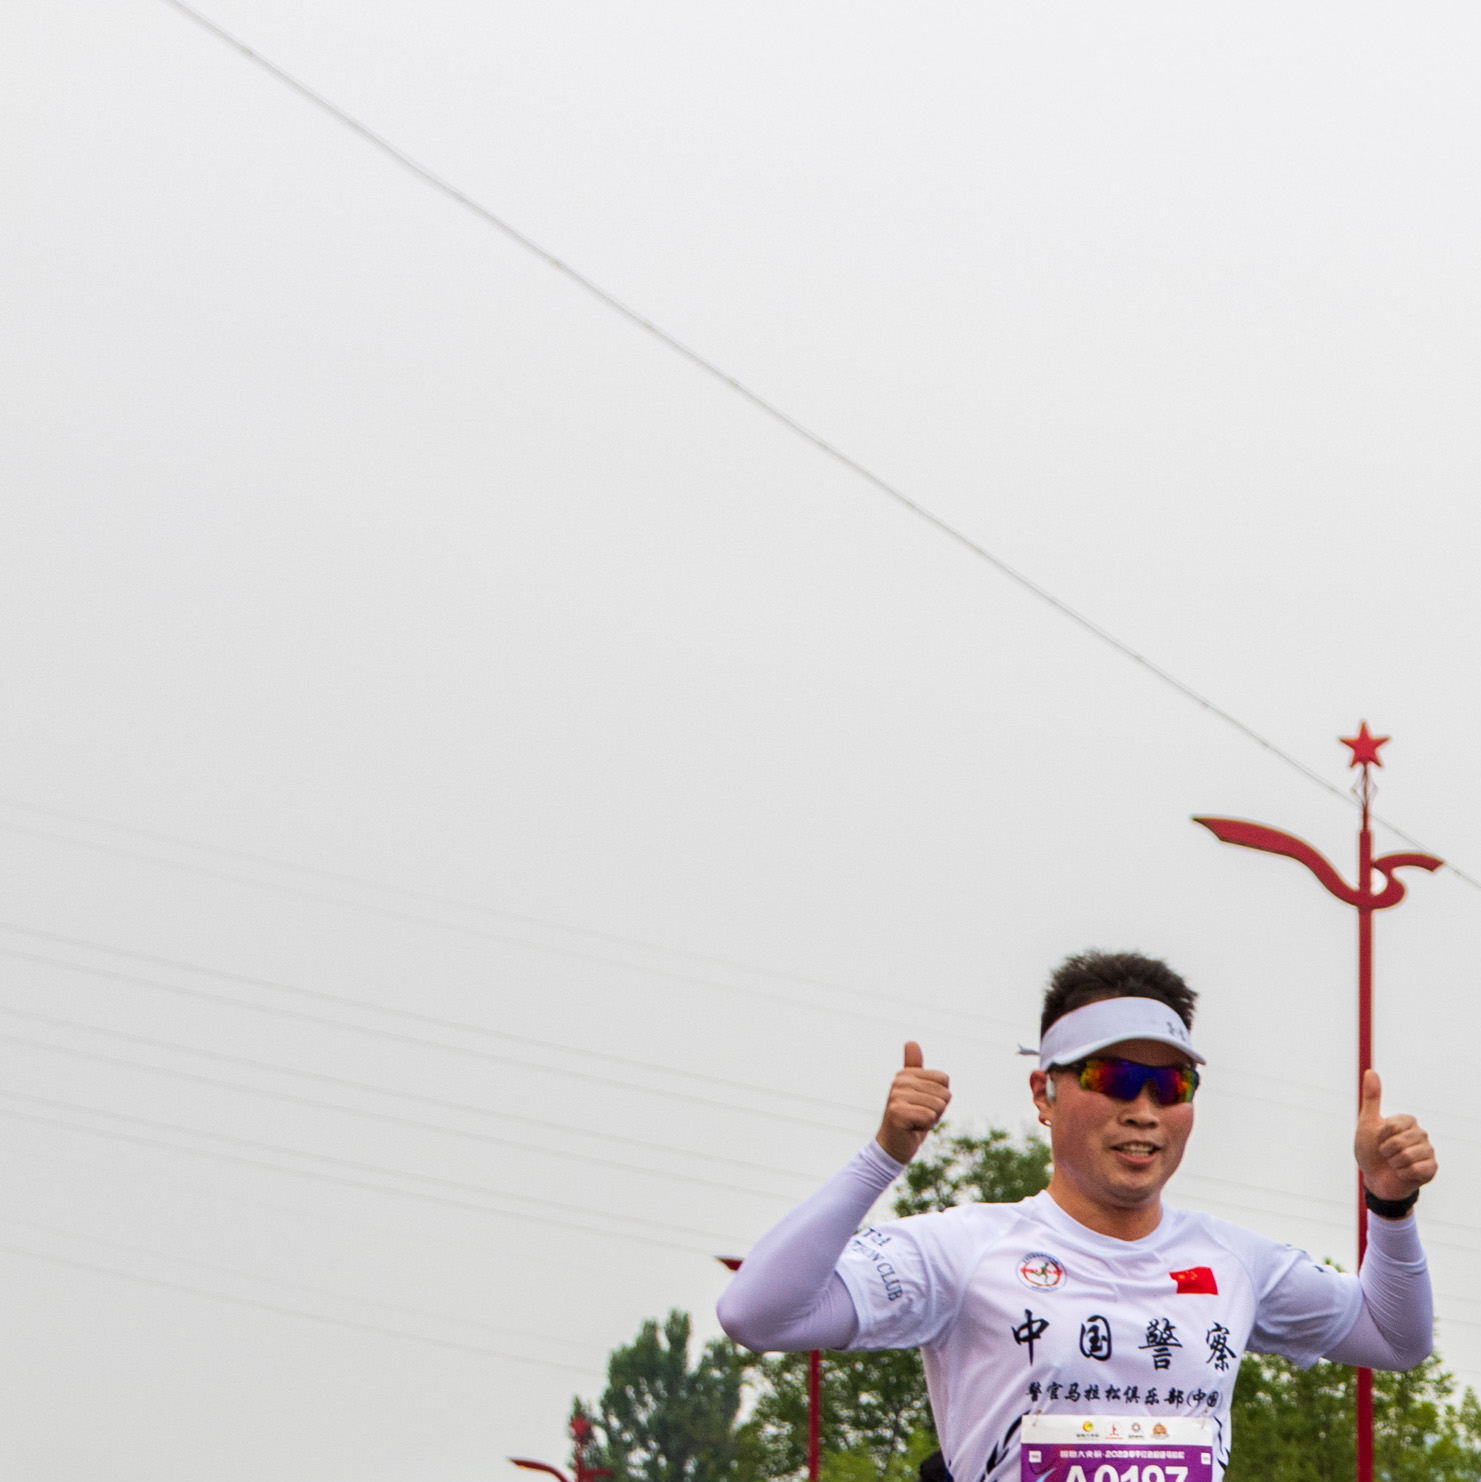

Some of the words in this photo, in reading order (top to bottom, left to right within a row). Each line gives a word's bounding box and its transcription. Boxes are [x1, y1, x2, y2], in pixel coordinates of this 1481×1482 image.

[876, 1263, 904, 1302] CLUB
[1011, 1309, 1237, 1372] 中国警察
